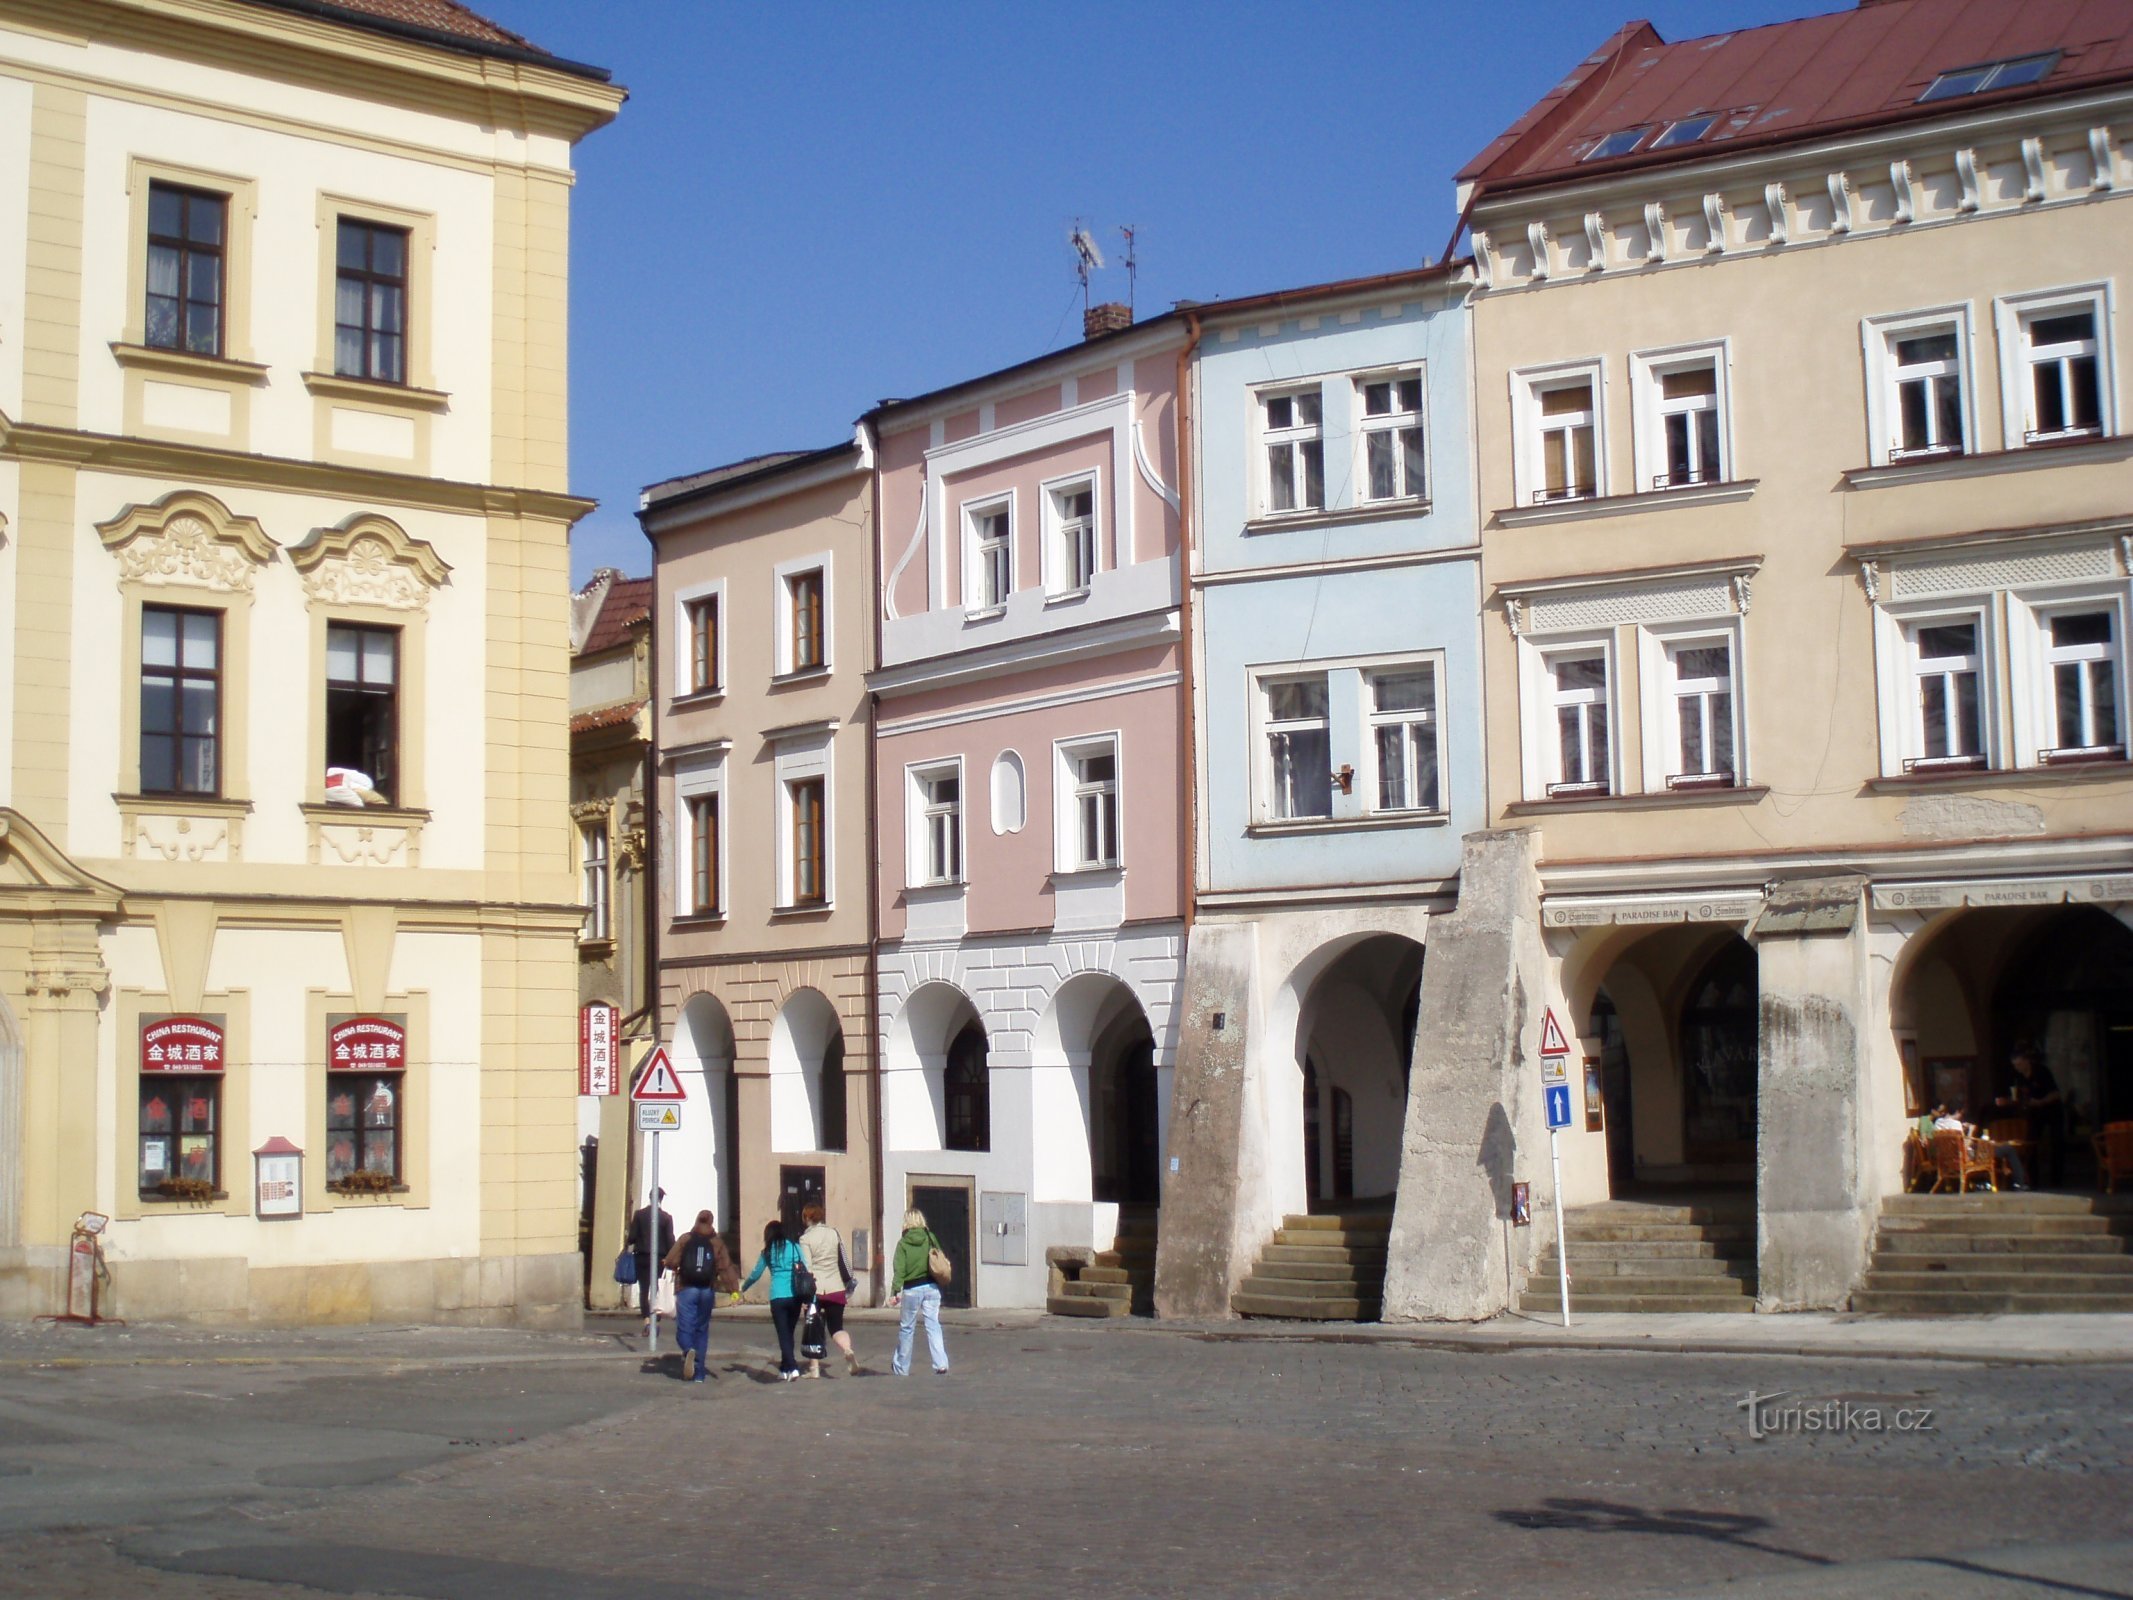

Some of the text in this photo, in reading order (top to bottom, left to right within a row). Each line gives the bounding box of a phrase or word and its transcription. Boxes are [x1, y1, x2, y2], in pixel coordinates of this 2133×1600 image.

[1984, 891, 2048, 901] PARADISE BAR
[1622, 909, 1679, 920] PARADISE BAR
[146, 1025, 222, 1043] CHINA RESTAURANT
[333, 1024, 403, 1041] CHINA RESTAURANT
[148, 1043, 219, 1061] 金城酒家
[335, 1043, 401, 1060] 金城酒家
[593, 1010, 606, 1080] 金城酒家
